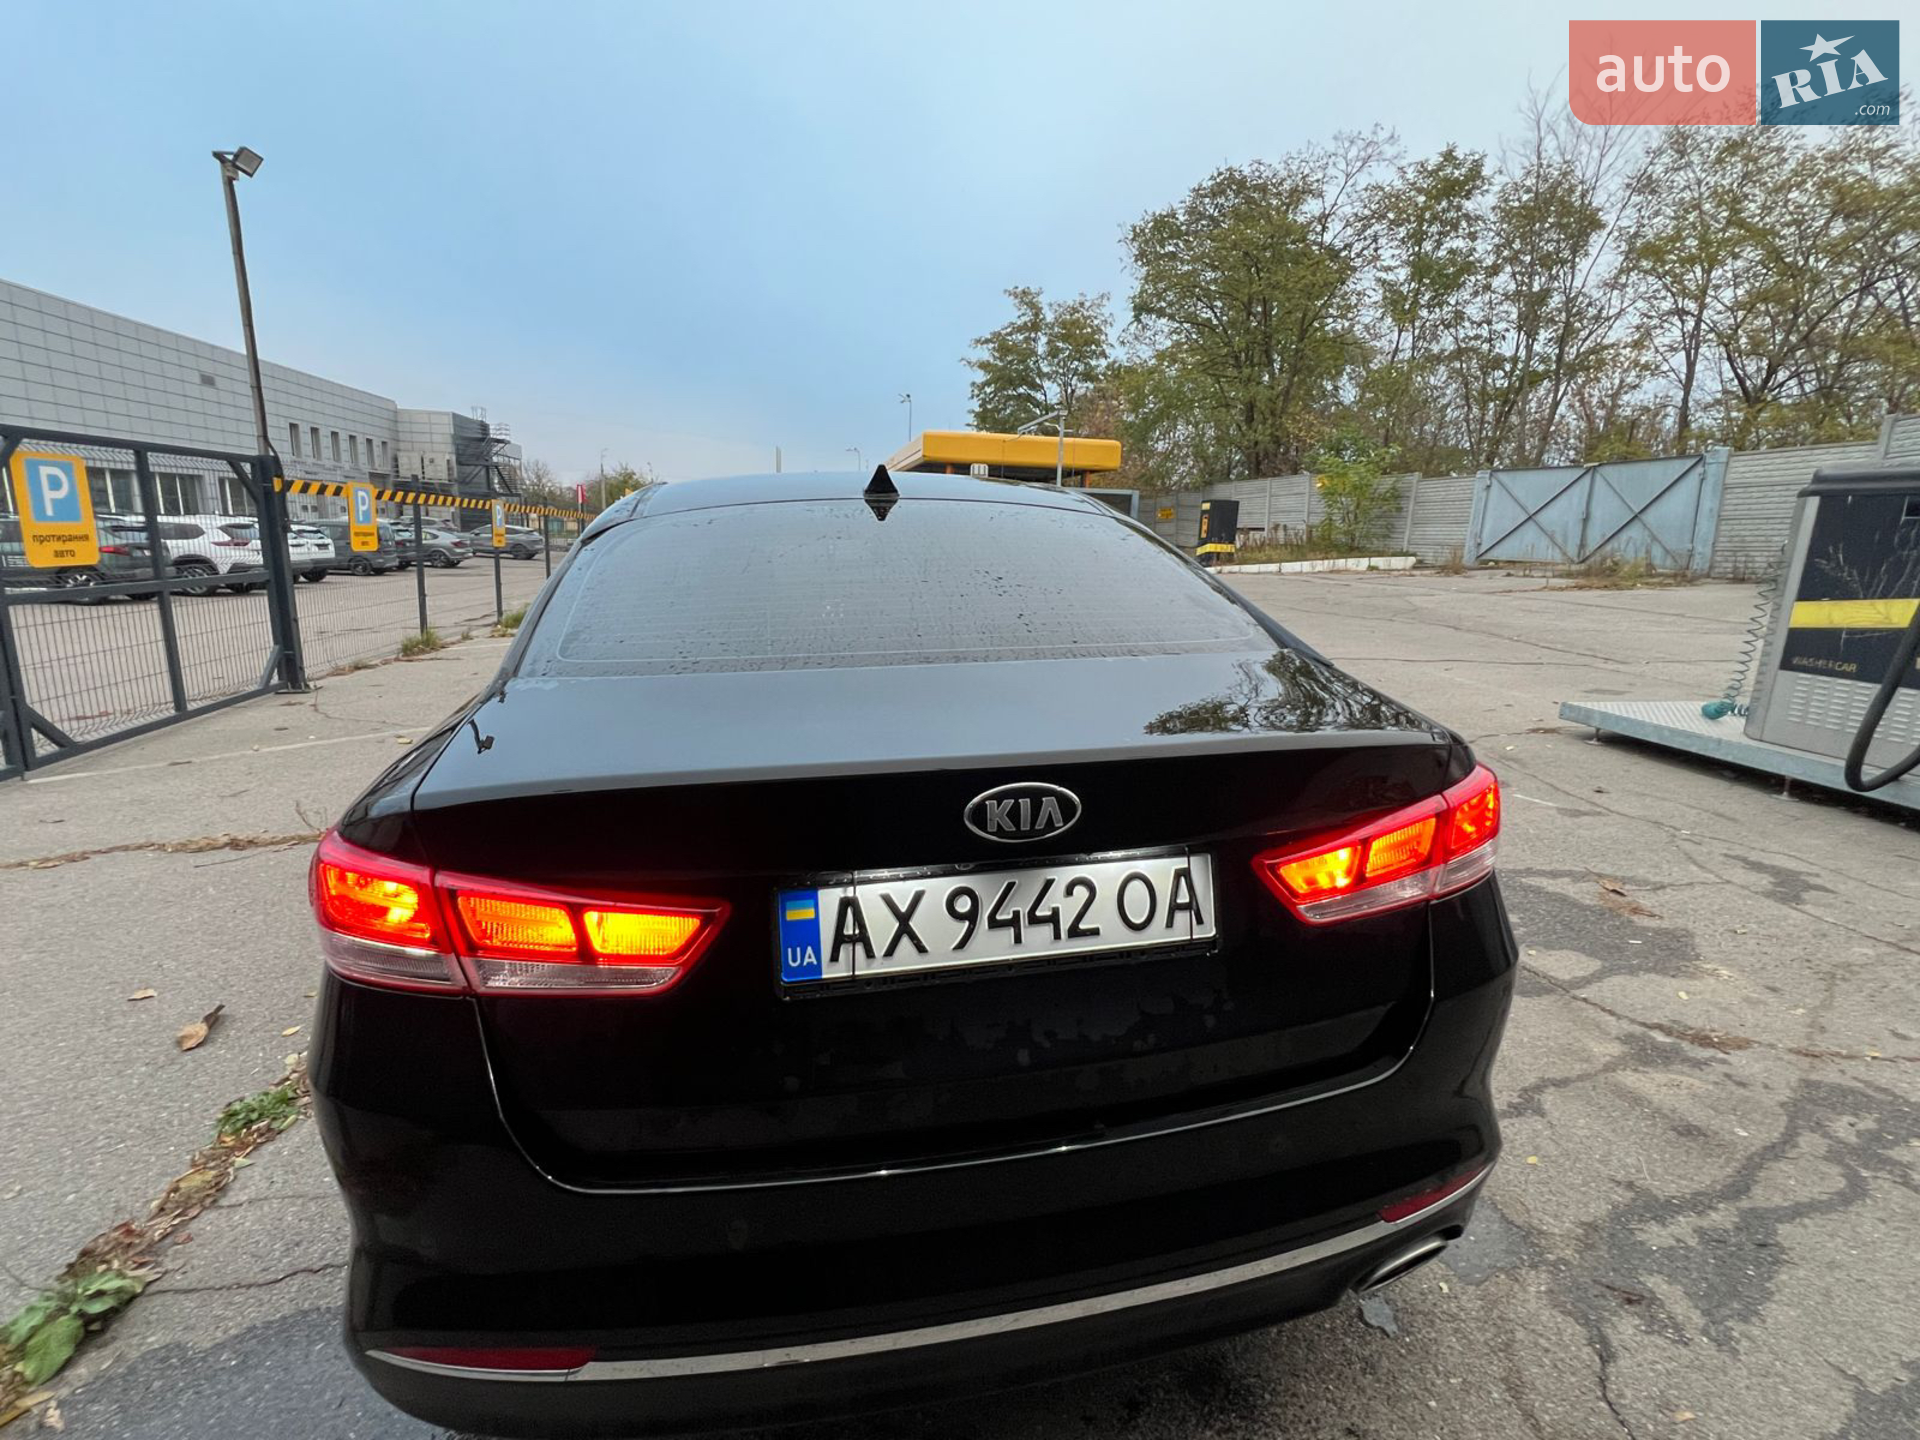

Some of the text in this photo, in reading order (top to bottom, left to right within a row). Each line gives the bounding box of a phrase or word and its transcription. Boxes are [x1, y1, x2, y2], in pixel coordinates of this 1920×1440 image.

[38, 465, 69, 516] P
[32, 533, 89, 545] протирання
[53, 549, 76, 558] авто
[985, 797, 1064, 832] KIA
[828, 868, 1204, 963] AX 9442 OA
[787, 946, 817, 967] UA
